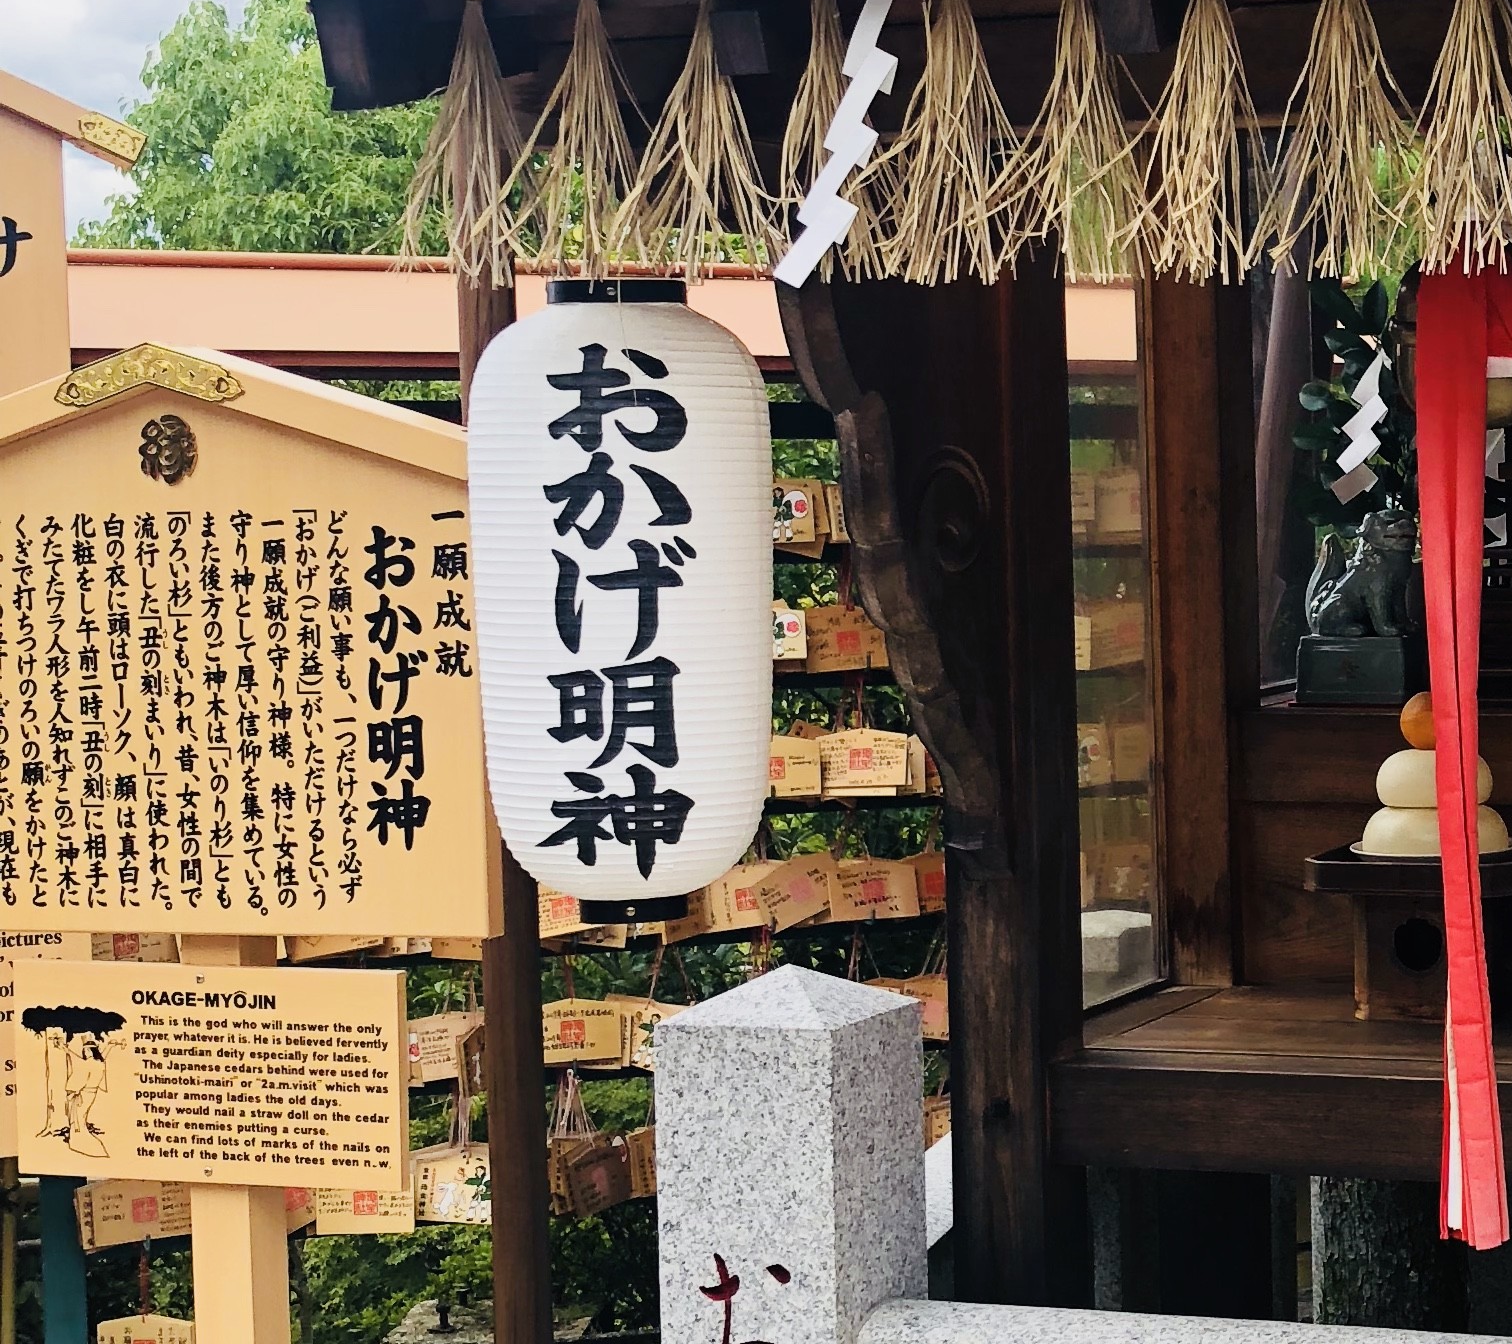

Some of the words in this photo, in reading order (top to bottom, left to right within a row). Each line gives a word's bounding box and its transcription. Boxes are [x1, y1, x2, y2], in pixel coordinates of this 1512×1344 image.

[430, 509, 474, 678] 一願成就
[535, 343, 697, 881] おかげ明神
[363, 525, 432, 851] おかげ明神
[0, 932, 63, 948] ictures
[131, 989, 277, 1010] OKAGE-MYÔJIN
[140, 1014, 165, 1026] This
[168, 1015, 179, 1027] is
[182, 1016, 202, 1028] the
[205, 1018, 228, 1031] god
[231, 1018, 258, 1030] who
[260, 1019, 283, 1031] will
[286, 1023, 330, 1032] answer
[332, 1022, 353, 1033] the
[356, 1023, 383, 1037] only
[172, 1031, 225, 1043] whatever
[227, 1033, 236, 1044] it
[253, 1033, 269, 1045] He
[271, 1034, 282, 1046] is
[285, 1035, 333, 1047] believed
[336, 1036, 389, 1052] fervently
[134, 1046, 148, 1055] as
[150, 1047, 159, 1055] a
[162, 1046, 213, 1061] guardian
[216, 1047, 246, 1062] deity
[249, 1049, 309, 1064] especially
[312, 1051, 330, 1062] for
[141, 1058, 163, 1070] The
[166, 1060, 221, 1074] Japanese
[224, 1063, 264, 1074] cedars
[266, 1063, 306, 1076] behind
[308, 1068, 337, 1077] were
[340, 1067, 369, 1078] used
[371, 1068, 389, 1079] for
[135, 1089, 179, 1102] popular
[183, 1092, 223, 1105] among
[226, 1091, 262, 1104] ladies
[265, 1093, 284, 1105] the
[288, 1094, 307, 1106] old
[240, 1080, 253, 1089] or
[324, 1081, 361, 1093] which
[364, 1085, 389, 1094] was
[142, 1102, 171, 1117] They
[175, 1105, 210, 1116] would
[214, 1106, 235, 1117] nail
[238, 1109, 246, 1118] a
[250, 1108, 283, 1119] straw
[286, 1109, 309, 1121] doll
[312, 1112, 328, 1121] on
[331, 1111, 351, 1122] the
[354, 1112, 390, 1124] cedar
[136, 1119, 150, 1128] as
[153, 1118, 180, 1129] their
[183, 1120, 233, 1132] enemies
[236, 1122, 278, 1137] putting
[282, 1126, 290, 1134] a
[143, 1131, 162, 1143] We
[165, 1135, 188, 1144] can
[190, 1134, 214, 1146] find
[217, 1135, 240, 1147] lots
[243, 1136, 256, 1148] of
[260, 1138, 298, 1150] marks
[302, 1139, 315, 1150] of
[319, 1140, 339, 1152] the
[342, 1141, 371, 1153] nails
[374, 1145, 391, 1154] on
[136, 1146, 156, 1158] the
[158, 1147, 179, 1159] left
[182, 1148, 195, 1159] of
[199, 1149, 218, 1161] the
[222, 1150, 251, 1162] back
[254, 1152, 267, 1163] of
[271, 1152, 291, 1164] the
[294, 1154, 326, 1166] trees
[331, 1158, 360, 1167] even
